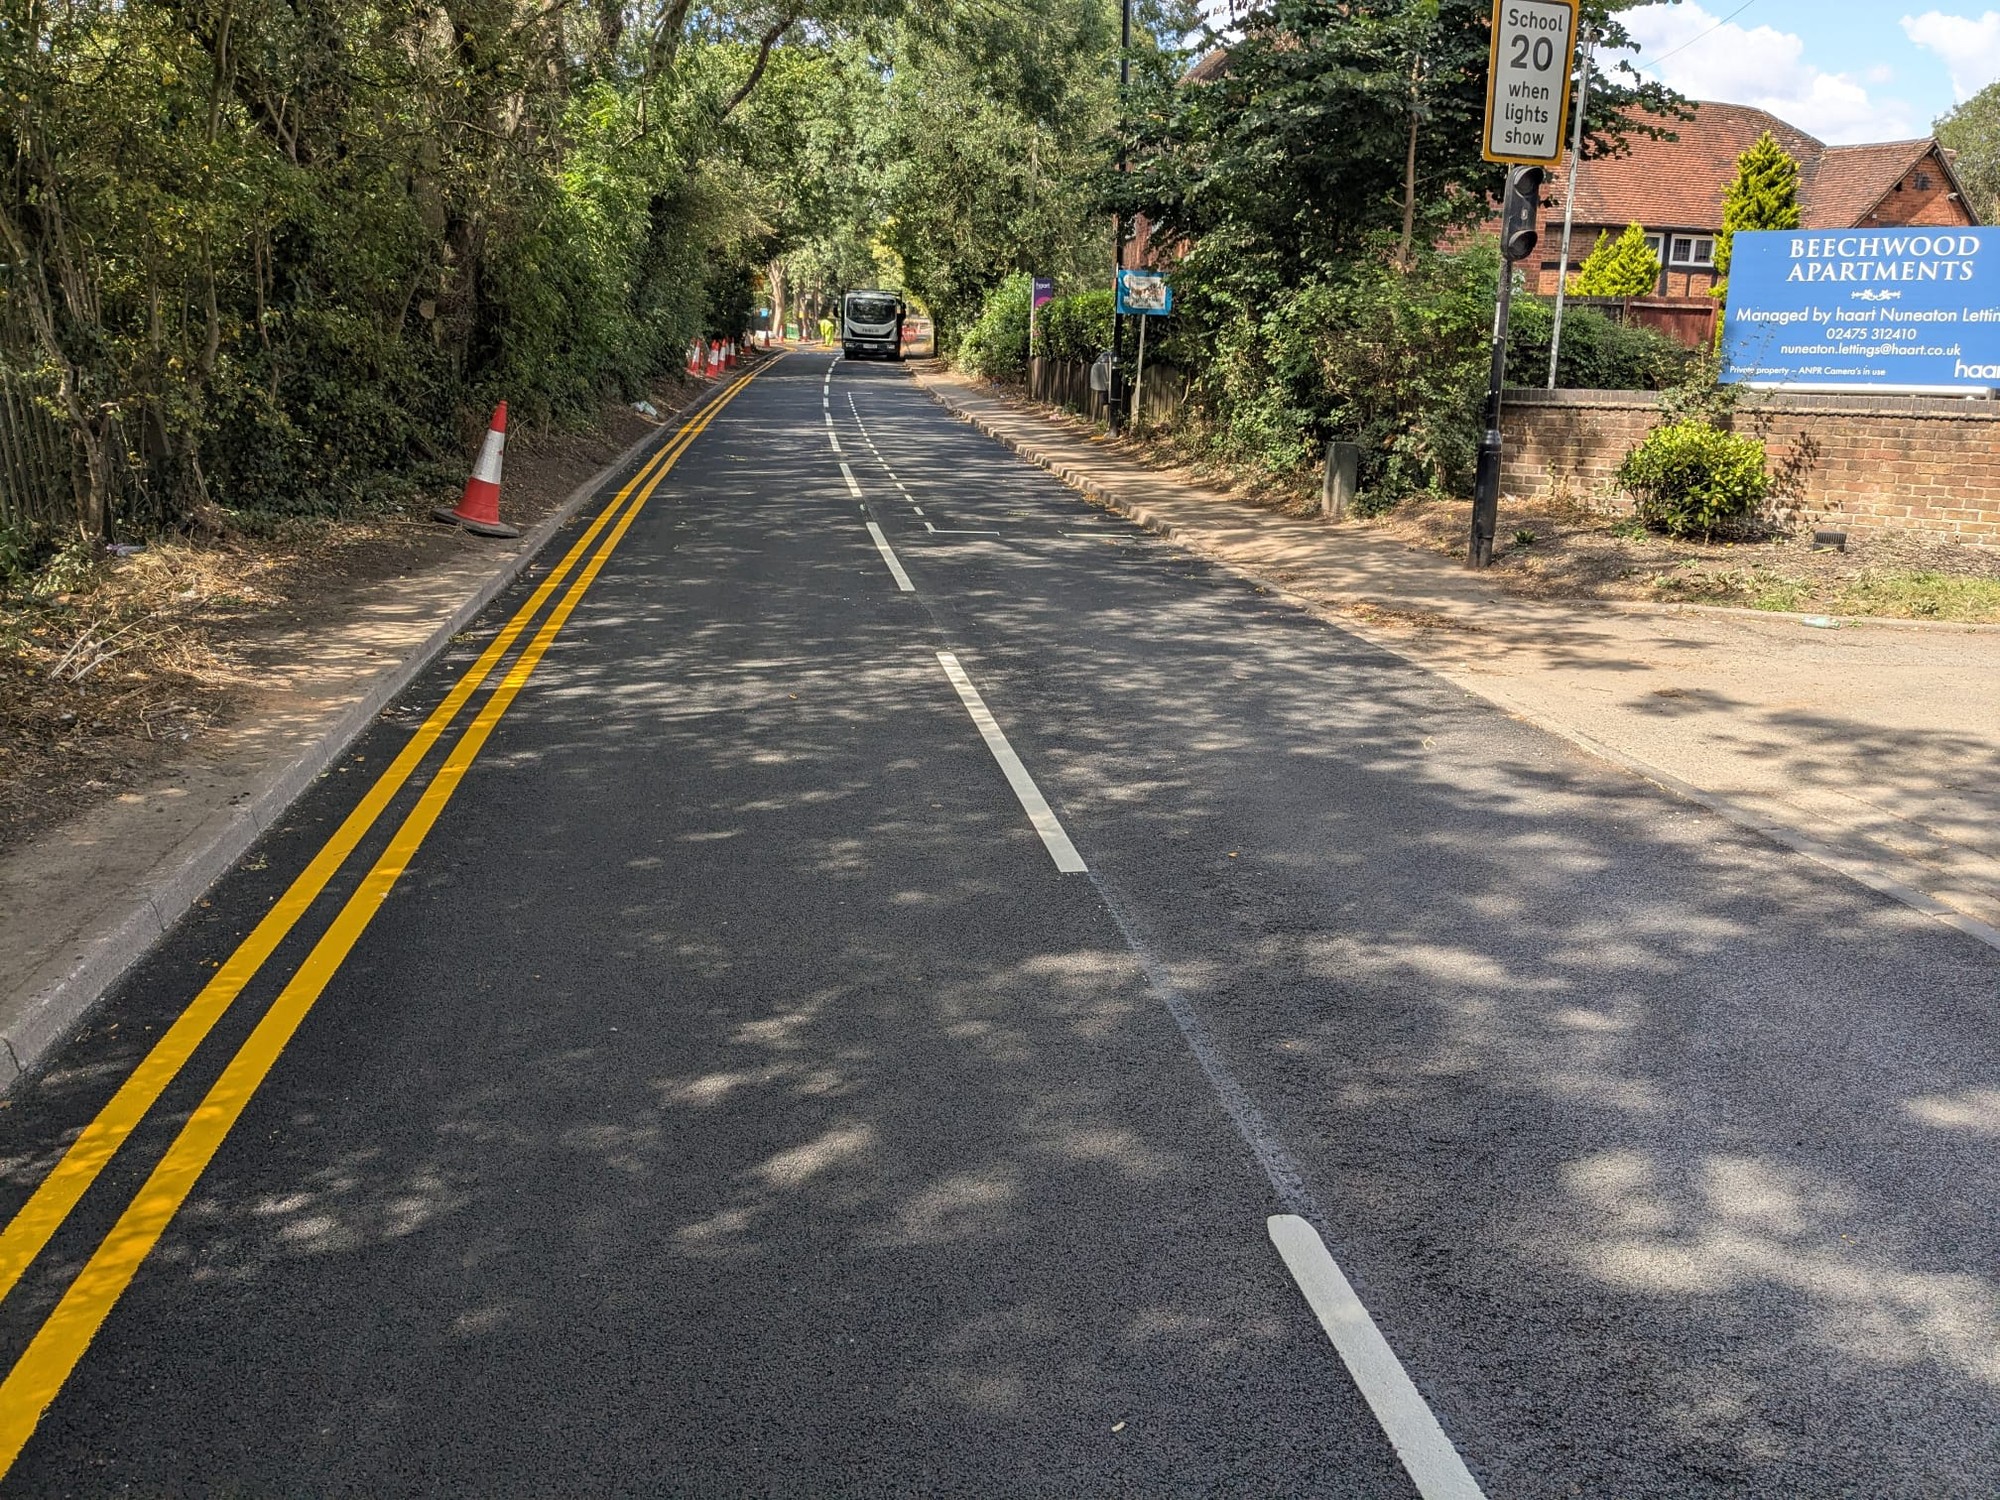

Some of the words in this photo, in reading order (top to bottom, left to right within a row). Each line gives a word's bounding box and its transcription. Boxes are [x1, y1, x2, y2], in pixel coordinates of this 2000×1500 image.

[1508, 8, 1562, 32] School
[1510, 34, 1553, 72] 20
[1508, 81, 1549, 100] when
[1505, 103, 1549, 124] lights
[1504, 127, 1545, 146] show
[1788, 236, 1980, 258] BEECHWOOD
[1786, 260, 1974, 281] APARTMENTS
[1736, 306, 1809, 325] Managed
[1812, 306, 1832, 325] by
[1835, 306, 1876, 322] haart
[1880, 307, 1957, 322] Nuneaton
[1826, 327, 1867, 340] 02475
[1871, 327, 1917, 340] 312410
[1780, 342, 1960, 358] nuneaton.lettings@haart.co.uk
[1729, 365, 1754, 375] Private
[1756, 366, 1789, 376] property
[1798, 366, 1823, 375] ANPR
[1863, 365, 1871, 375] in
[1872, 368, 1887, 376] use
